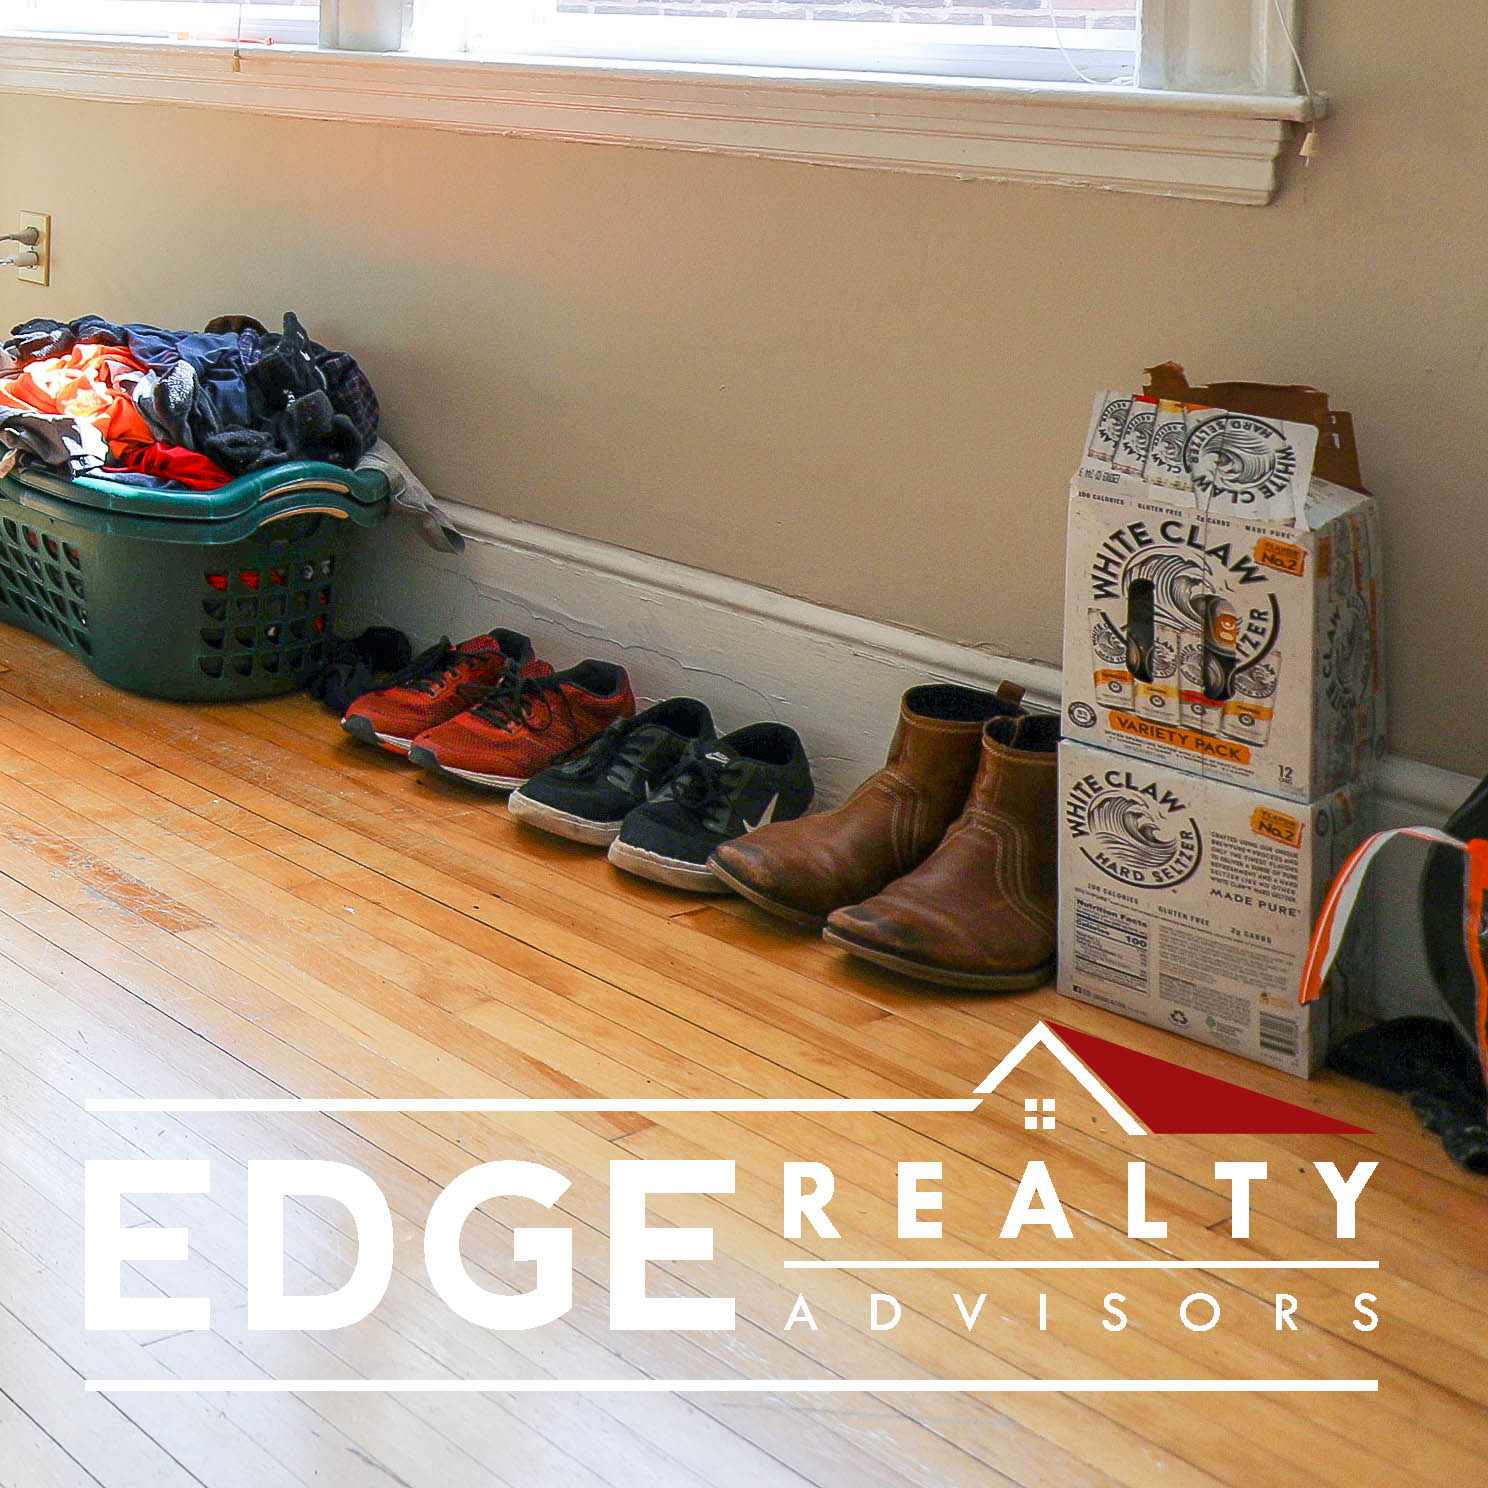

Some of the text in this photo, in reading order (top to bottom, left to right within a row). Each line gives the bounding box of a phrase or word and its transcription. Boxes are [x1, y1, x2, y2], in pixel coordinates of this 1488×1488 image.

[1231, 419, 1273, 439] HARD
[1187, 420, 1227, 465] SELTZER
[1192, 446, 1297, 504] WHITE CLAW
[1092, 492, 1125, 505] CALORIES
[1137, 503, 1182, 517] GLUTEN FREE
[1091, 520, 1268, 600] WHITE CLAW
[1235, 608, 1269, 659] TZER
[1116, 717, 1191, 747] VARIETY
[1194, 737, 1241, 761] PACK
[1278, 764, 1293, 778] 12
[1066, 771, 1186, 839] WHITE CLAW
[1095, 830, 1194, 883] HARD SELTZER
[1088, 883, 1139, 905] 100 CALORIES
[1210, 889, 1252, 906] MADE
[1076, 899, 1119, 919] Nutrition
[1158, 906, 1210, 926] GLUTEN FREE
[1075, 918, 1147, 948] Calories 100
[1243, 930, 1272, 944] CARBS
